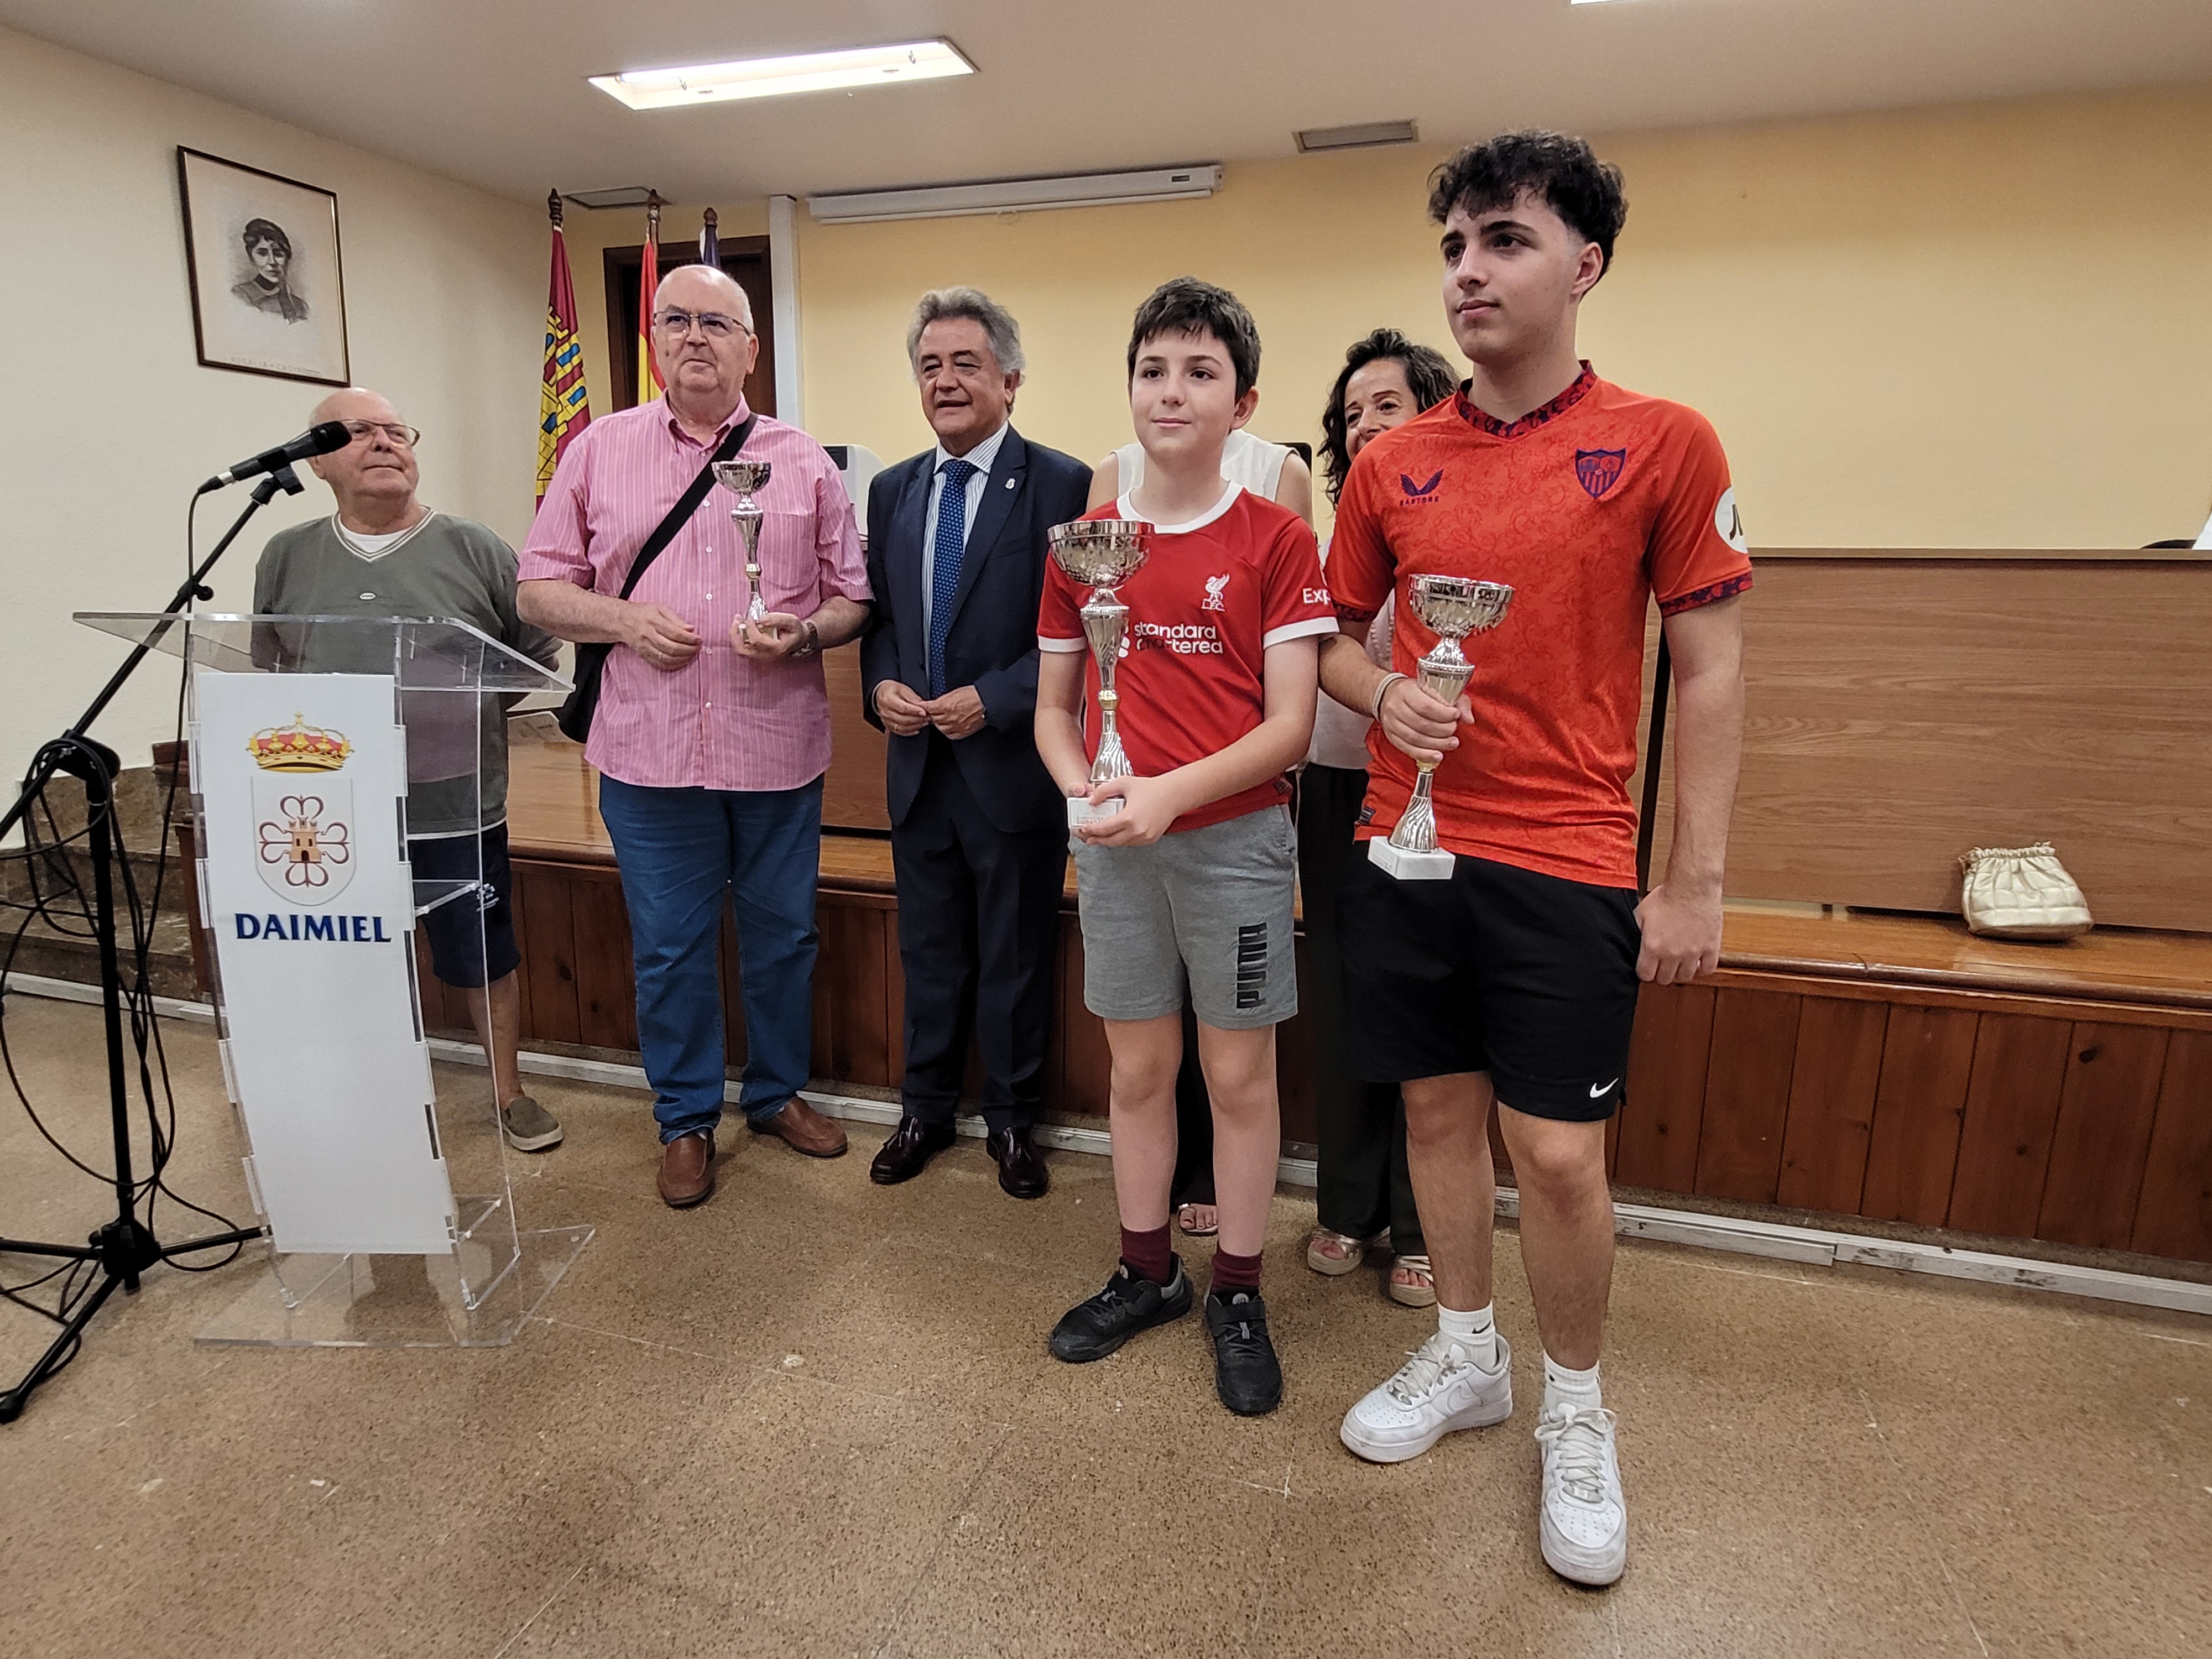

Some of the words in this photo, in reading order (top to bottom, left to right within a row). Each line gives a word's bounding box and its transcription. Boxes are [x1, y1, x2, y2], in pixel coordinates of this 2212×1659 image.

[1201, 601, 1225, 612] LFC
[1134, 620, 1217, 639] standard
[236, 913, 392, 942] DAIMIEL
[1236, 922, 1268, 1009] PUMA
